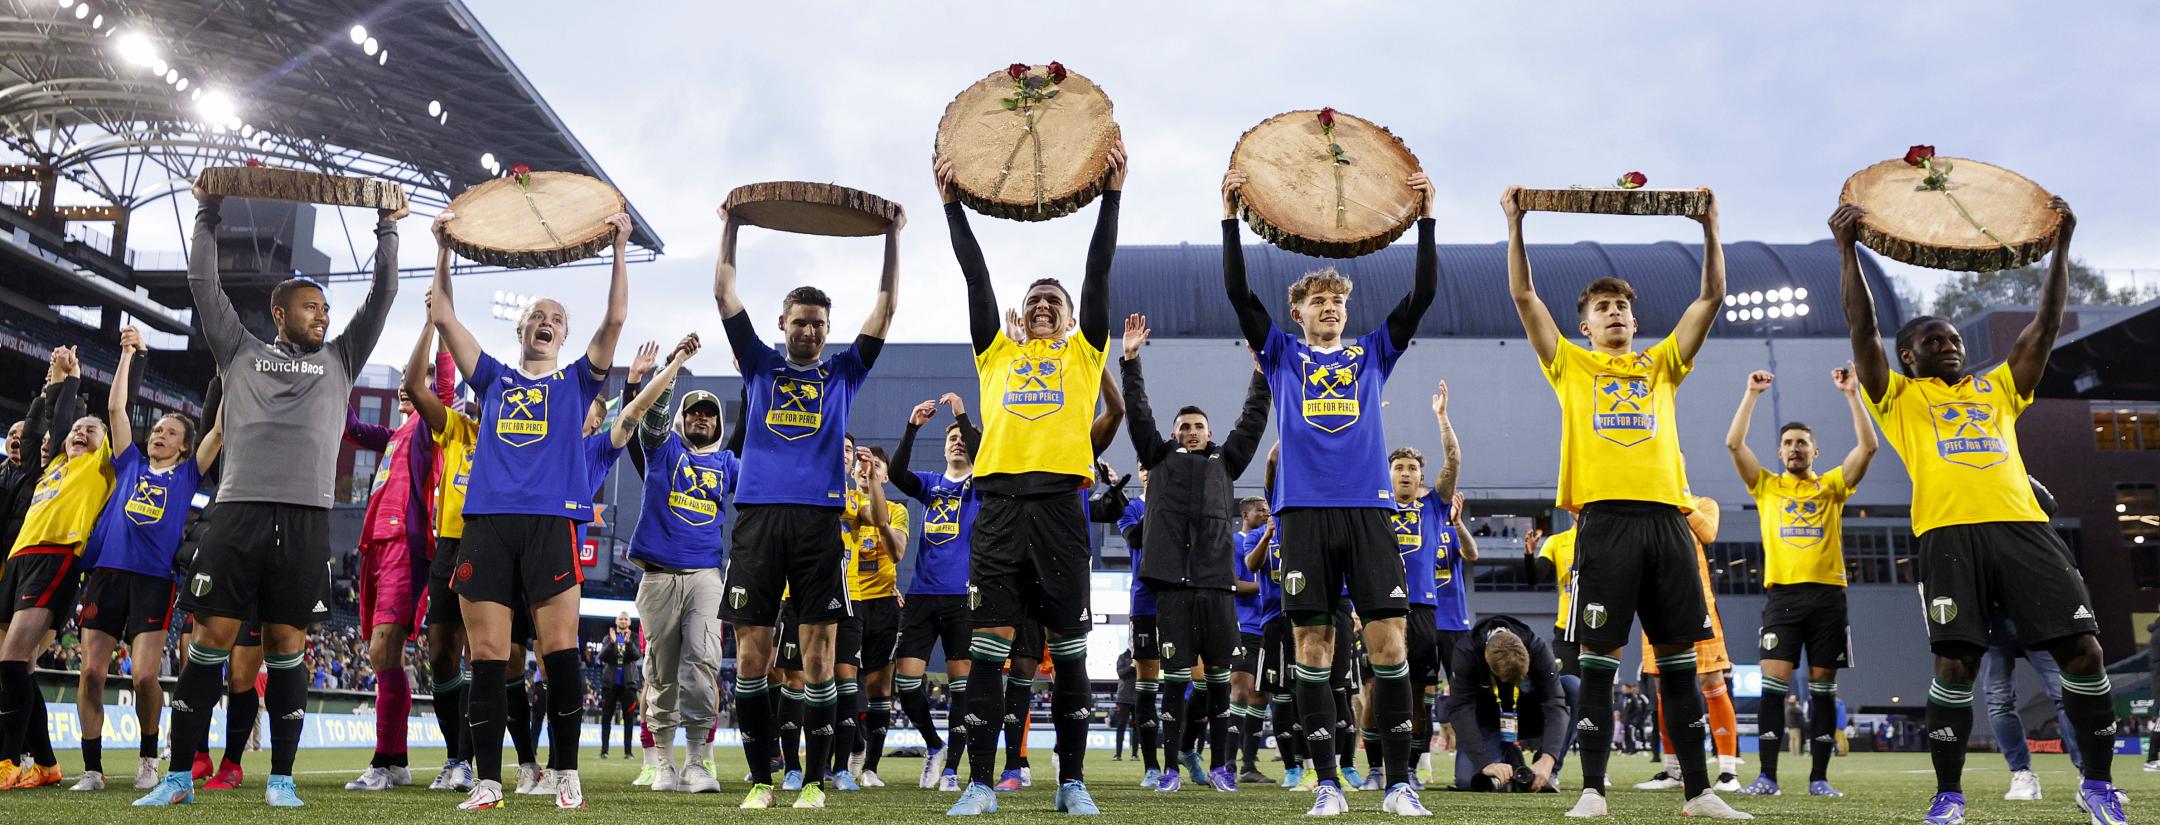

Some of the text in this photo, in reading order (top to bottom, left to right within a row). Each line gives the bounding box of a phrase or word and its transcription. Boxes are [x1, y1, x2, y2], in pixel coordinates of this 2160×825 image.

[262, 359, 324, 375] DUTCH BROS
[698, 391, 709, 400] P
[1008, 392, 1059, 402] PTFC FOR PEACE
[1307, 402, 1355, 412] PTFC FOR PEACE
[785, 413, 797, 423] FOR
[799, 414, 817, 425] PEACE
[1599, 417, 1617, 426] PTFC
[1617, 416, 1630, 426] FOR
[513, 421, 524, 431] FOR
[525, 422, 543, 432] PEACE
